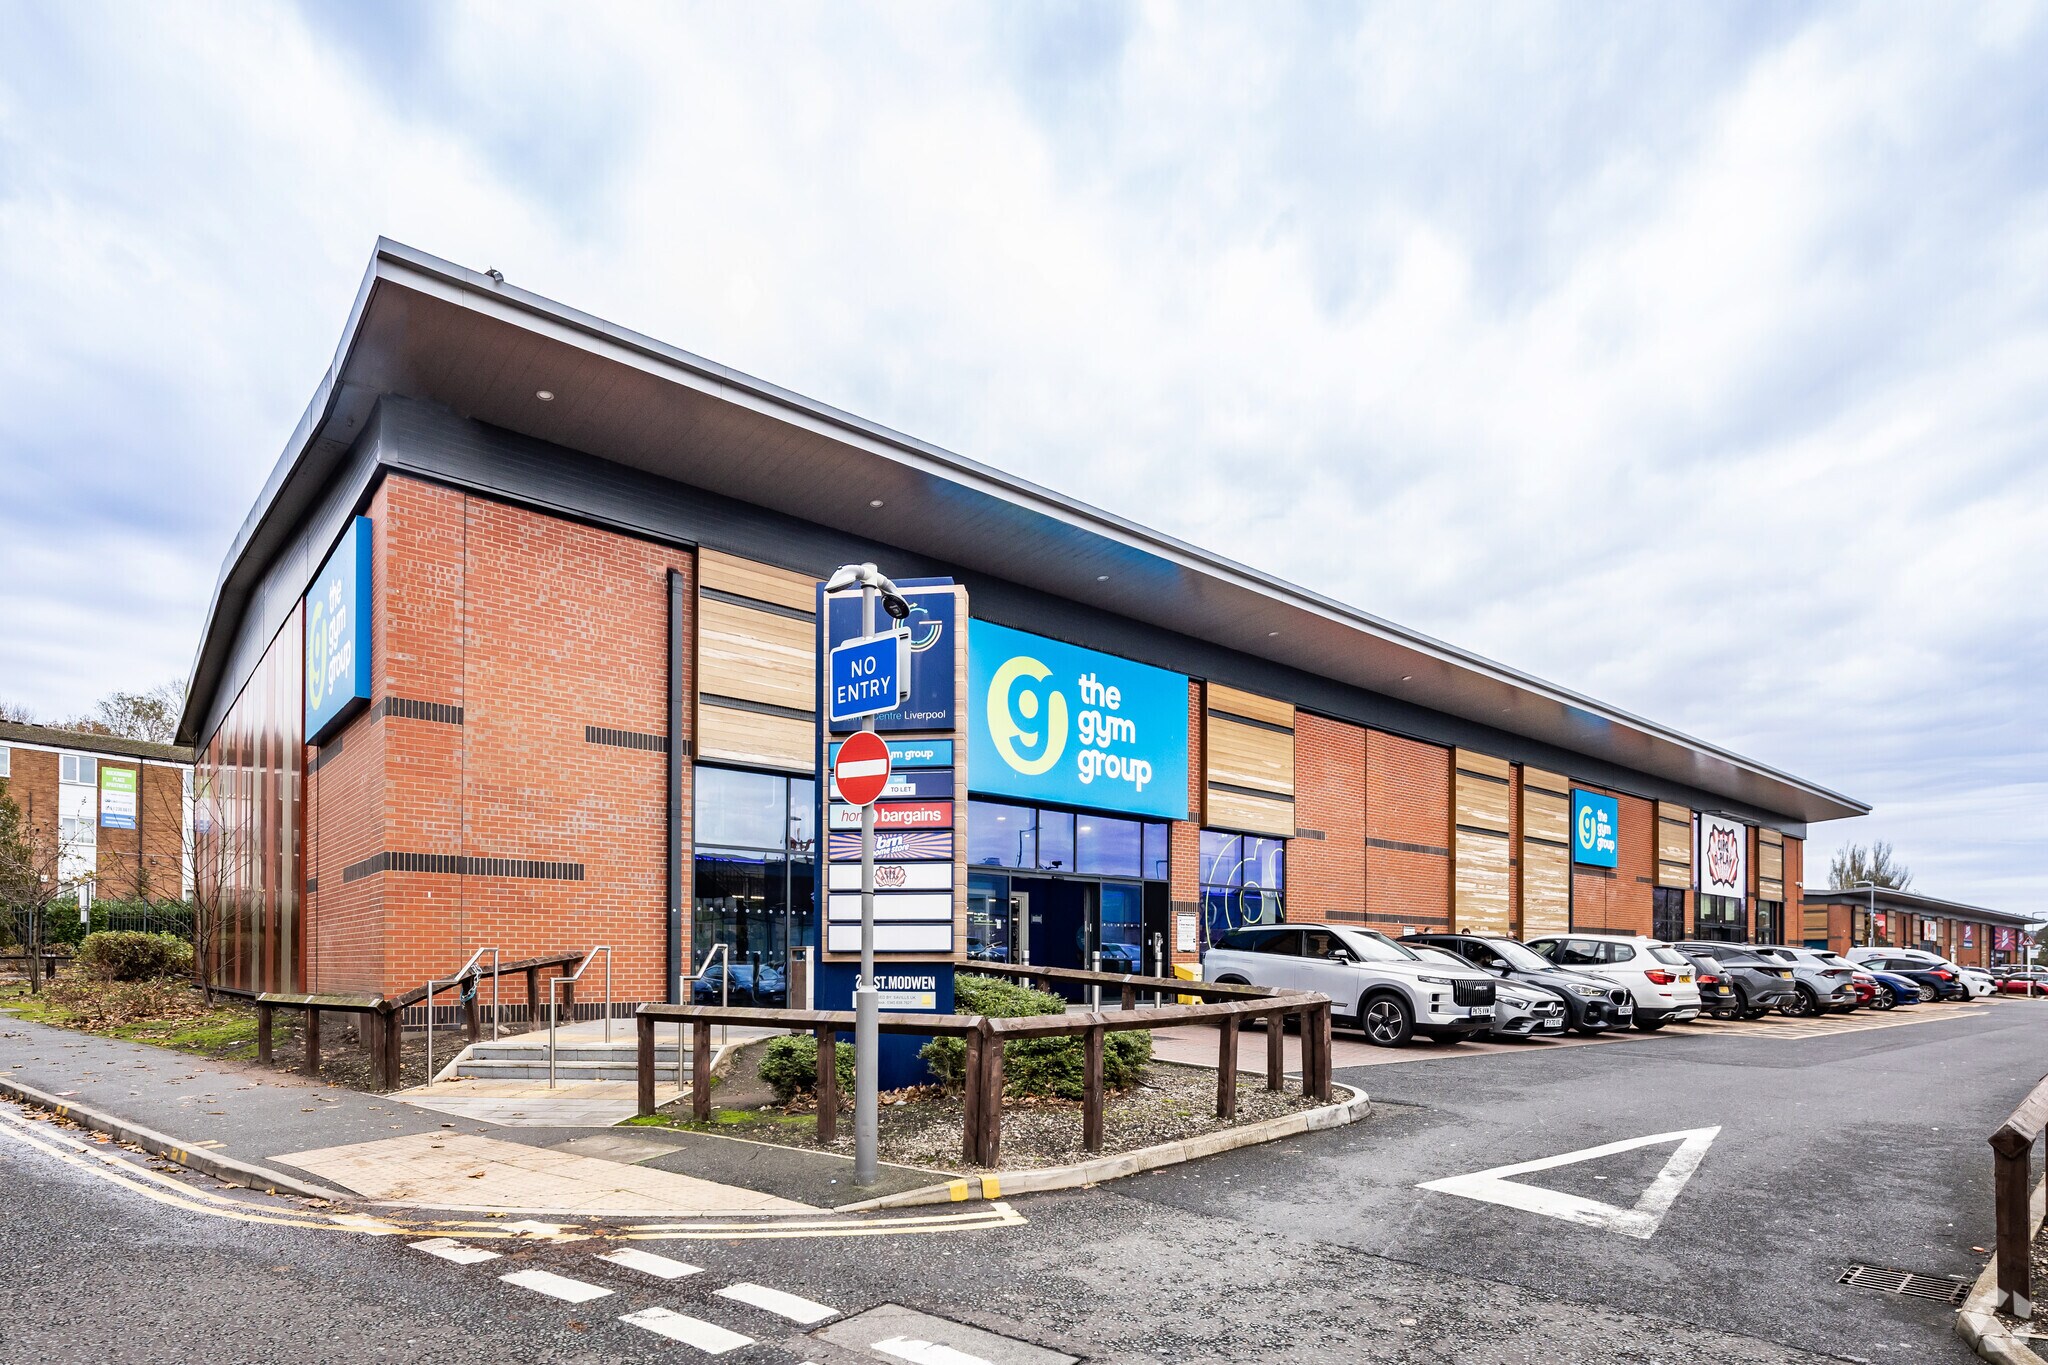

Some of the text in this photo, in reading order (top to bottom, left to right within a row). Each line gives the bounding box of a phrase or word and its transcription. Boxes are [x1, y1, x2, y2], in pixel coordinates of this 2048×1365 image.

[329, 578, 342, 614] the
[328, 604, 347, 655] gym
[328, 639, 351, 695] group
[851, 656, 876, 678] NO
[837, 676, 891, 704] ENTRY
[1078, 672, 1121, 710] the
[904, 710, 946, 720] Liverpool
[1077, 710, 1136, 748] gym
[890, 750, 934, 760] ym group
[1077, 749, 1152, 792] group
[881, 808, 942, 825] bargains
[1597, 809, 1608, 823] the
[1597, 823, 1611, 837] gym
[873, 843, 910, 857] ome store
[1597, 837, 1615, 854] group
[874, 976, 936, 990] ST.MODWEN
